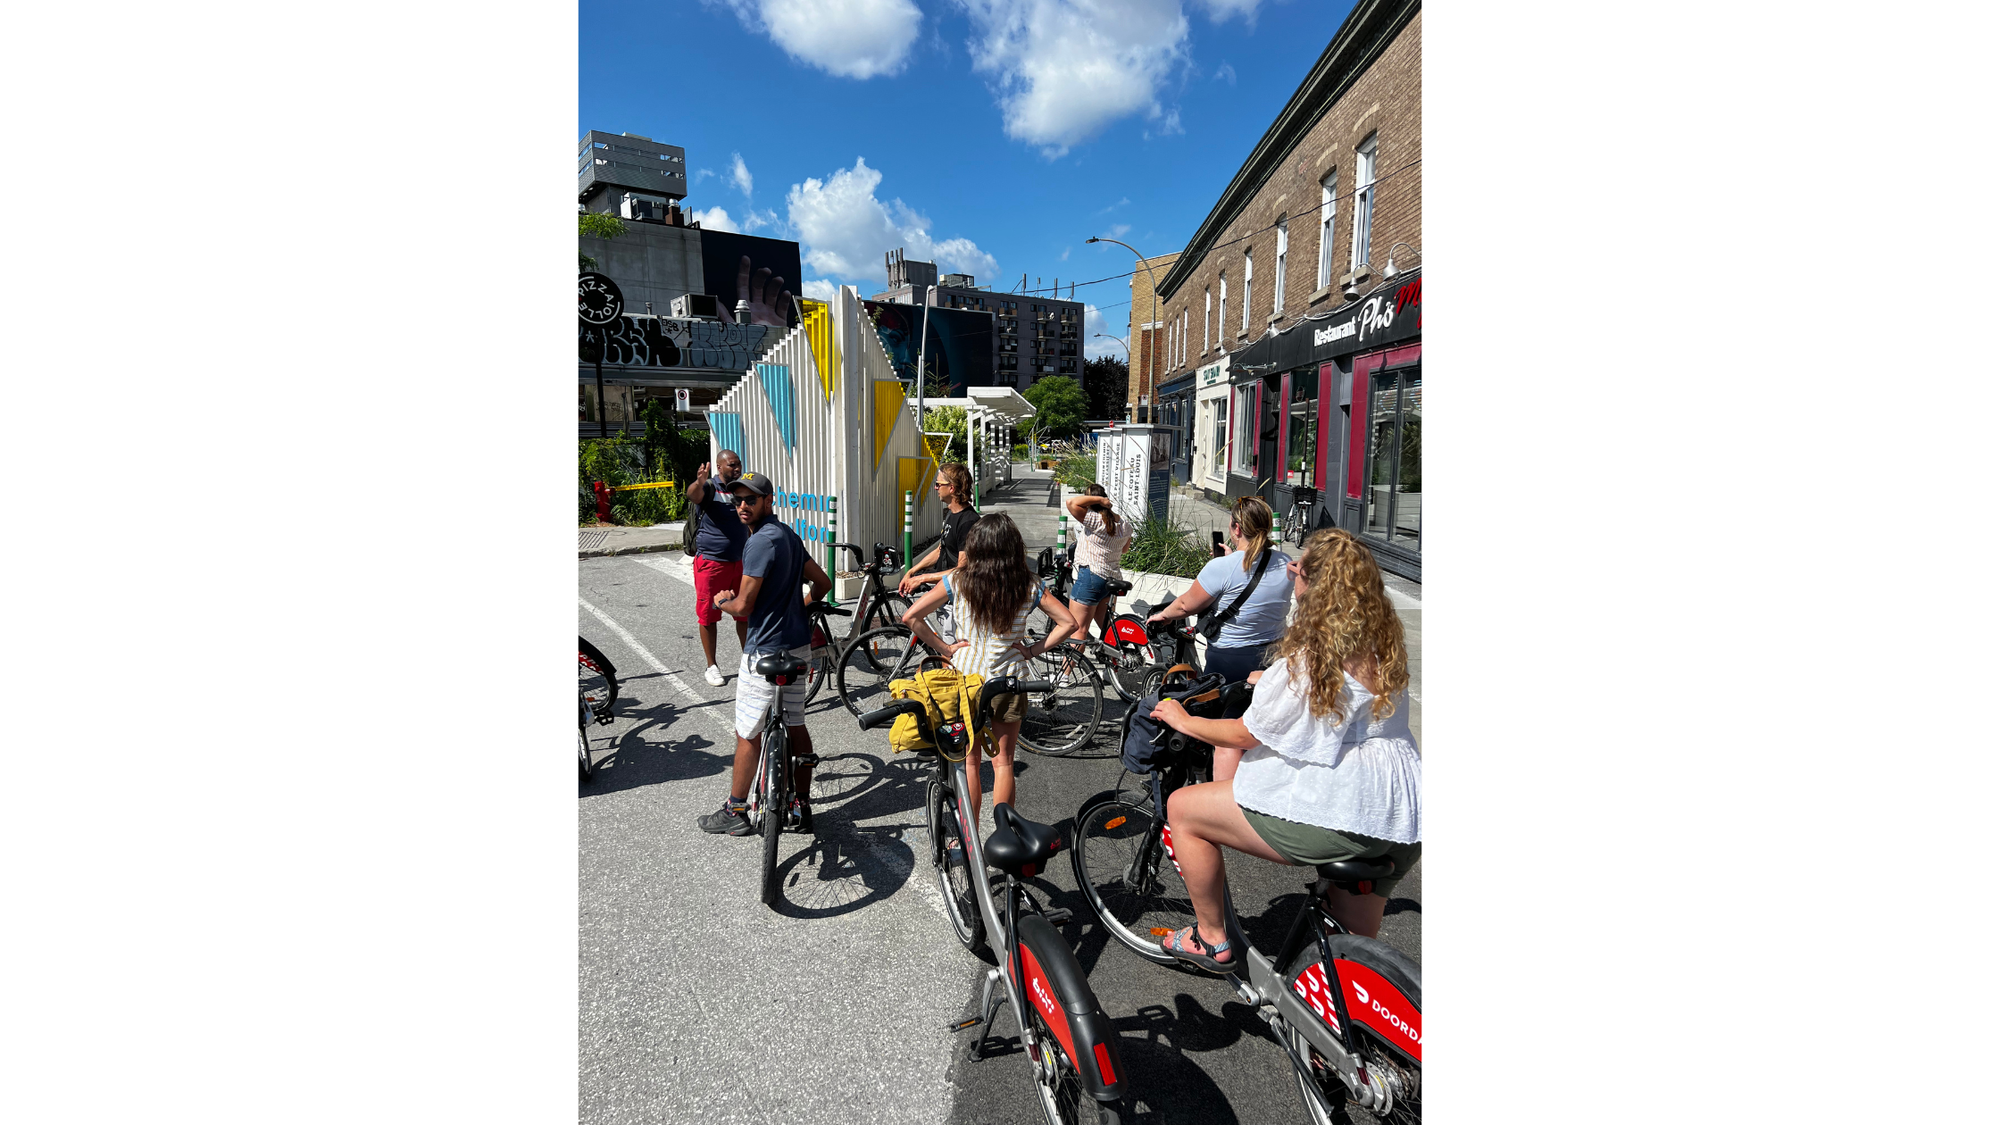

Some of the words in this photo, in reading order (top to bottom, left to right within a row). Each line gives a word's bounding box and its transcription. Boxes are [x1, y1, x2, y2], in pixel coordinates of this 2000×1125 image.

[578, 281, 615, 319] PIZZAIOLLE
[1314, 316, 1356, 347] Restaurant
[741, 472, 754, 480] M
[1128, 492, 1133, 501] LE
